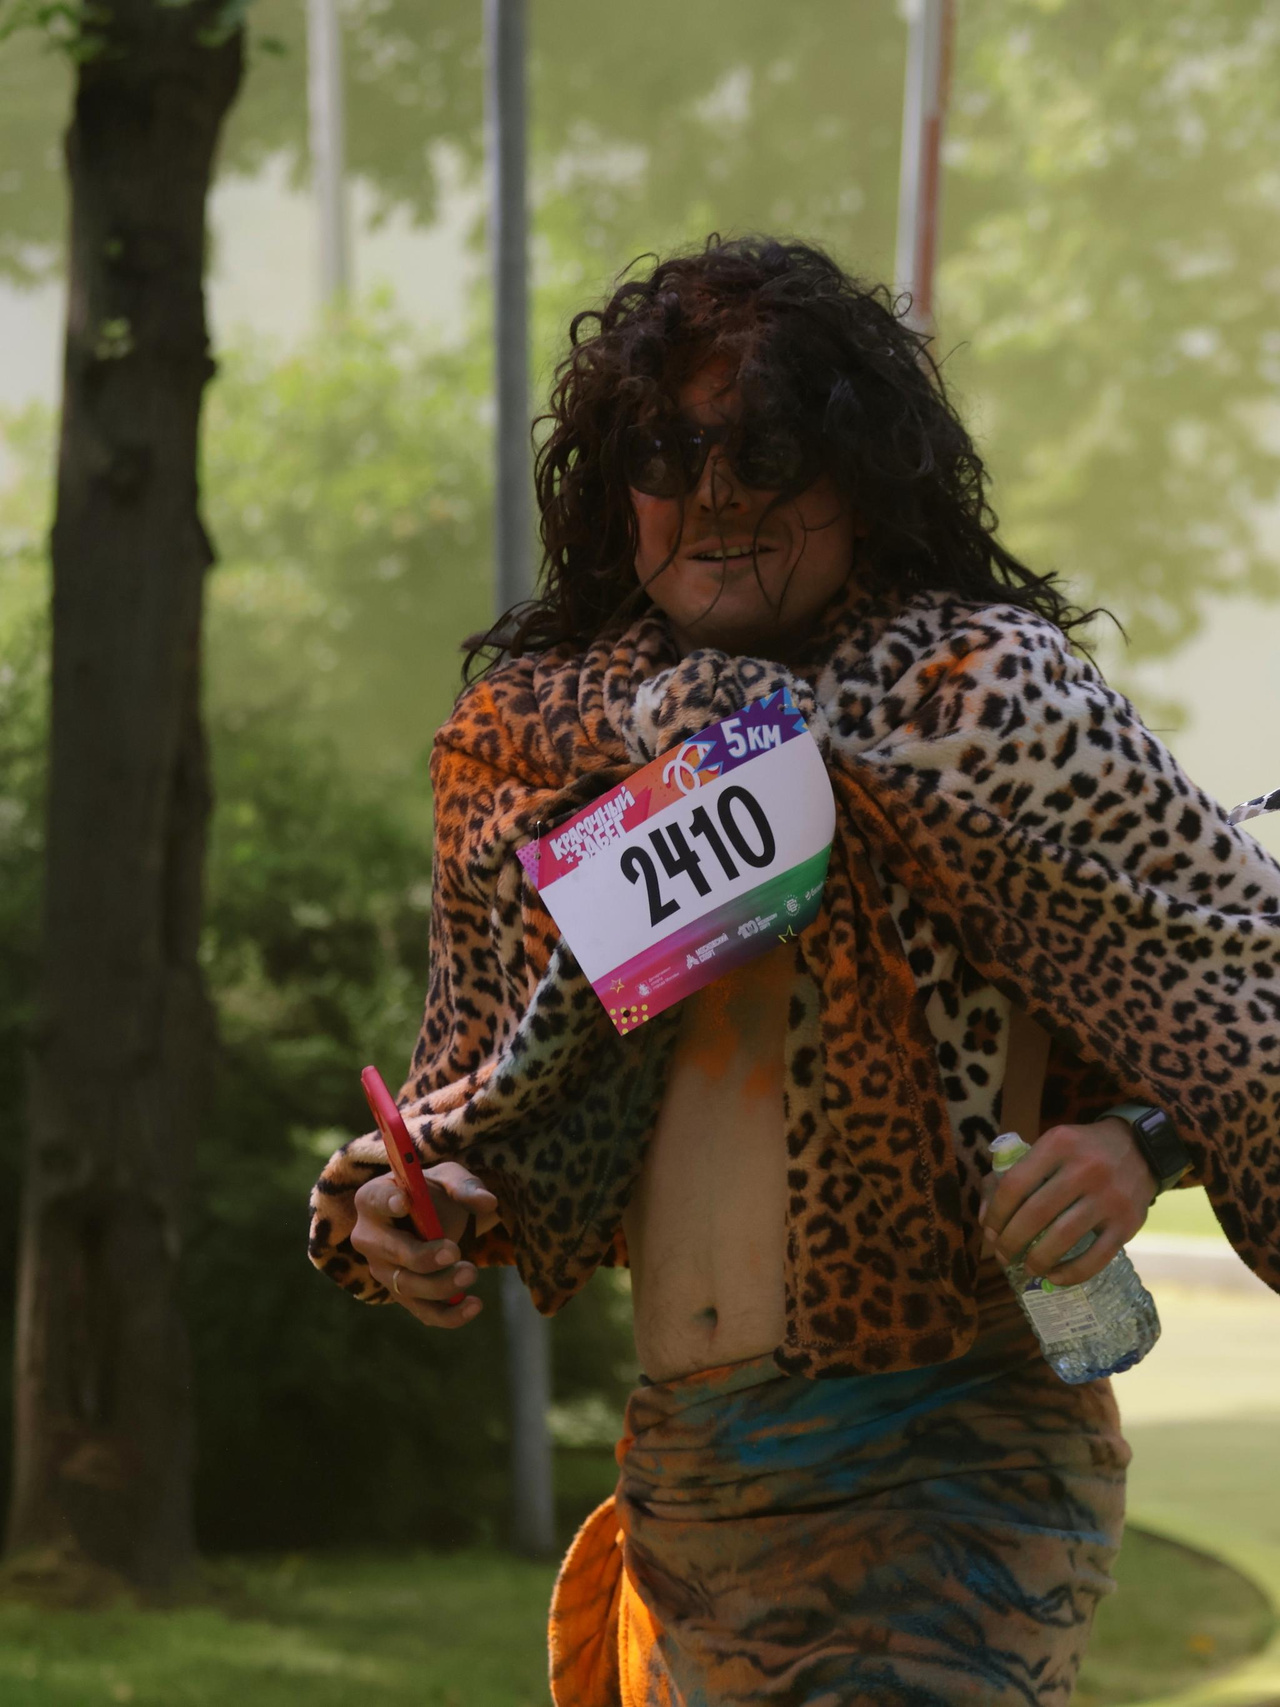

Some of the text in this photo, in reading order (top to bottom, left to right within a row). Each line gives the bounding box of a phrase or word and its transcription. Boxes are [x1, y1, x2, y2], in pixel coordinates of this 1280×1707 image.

[549, 786, 635, 861] КРАСОЧНЫЙ
[570, 812, 627, 866] ЗАБЕГ
[620, 785, 776, 928] 2410
